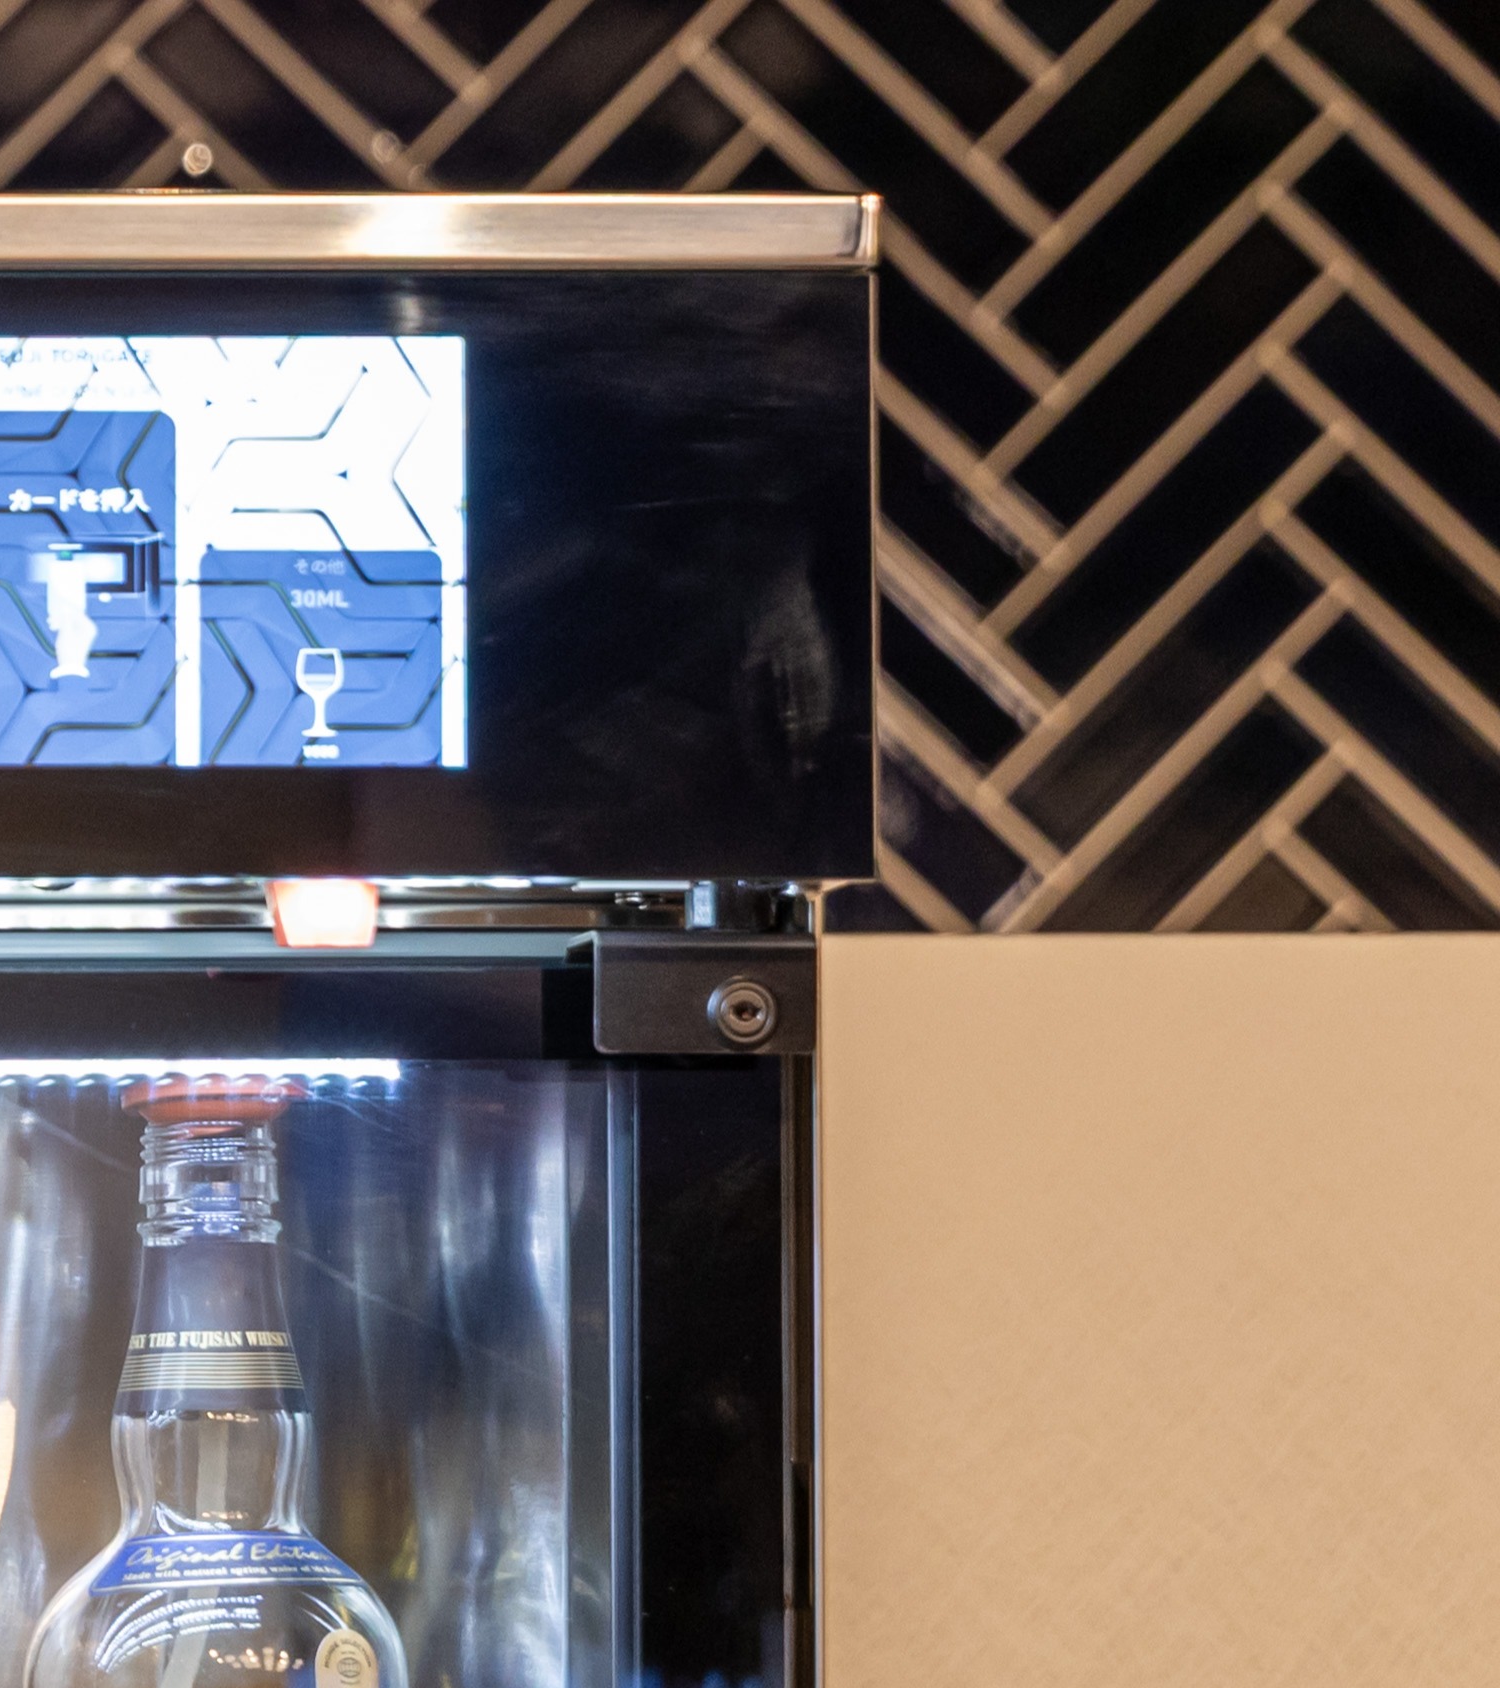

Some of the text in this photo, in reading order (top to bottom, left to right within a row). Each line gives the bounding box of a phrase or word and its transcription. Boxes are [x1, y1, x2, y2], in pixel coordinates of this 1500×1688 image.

[290, 589, 350, 608] 30ML
[148, 1333, 176, 1347] THE
[179, 1331, 242, 1350] FUJISAN
[127, 1543, 243, 1571] Original
[155, 1569, 180, 1578] with
[183, 1567, 227, 1577] natural
[231, 1565, 268, 1577] spring
